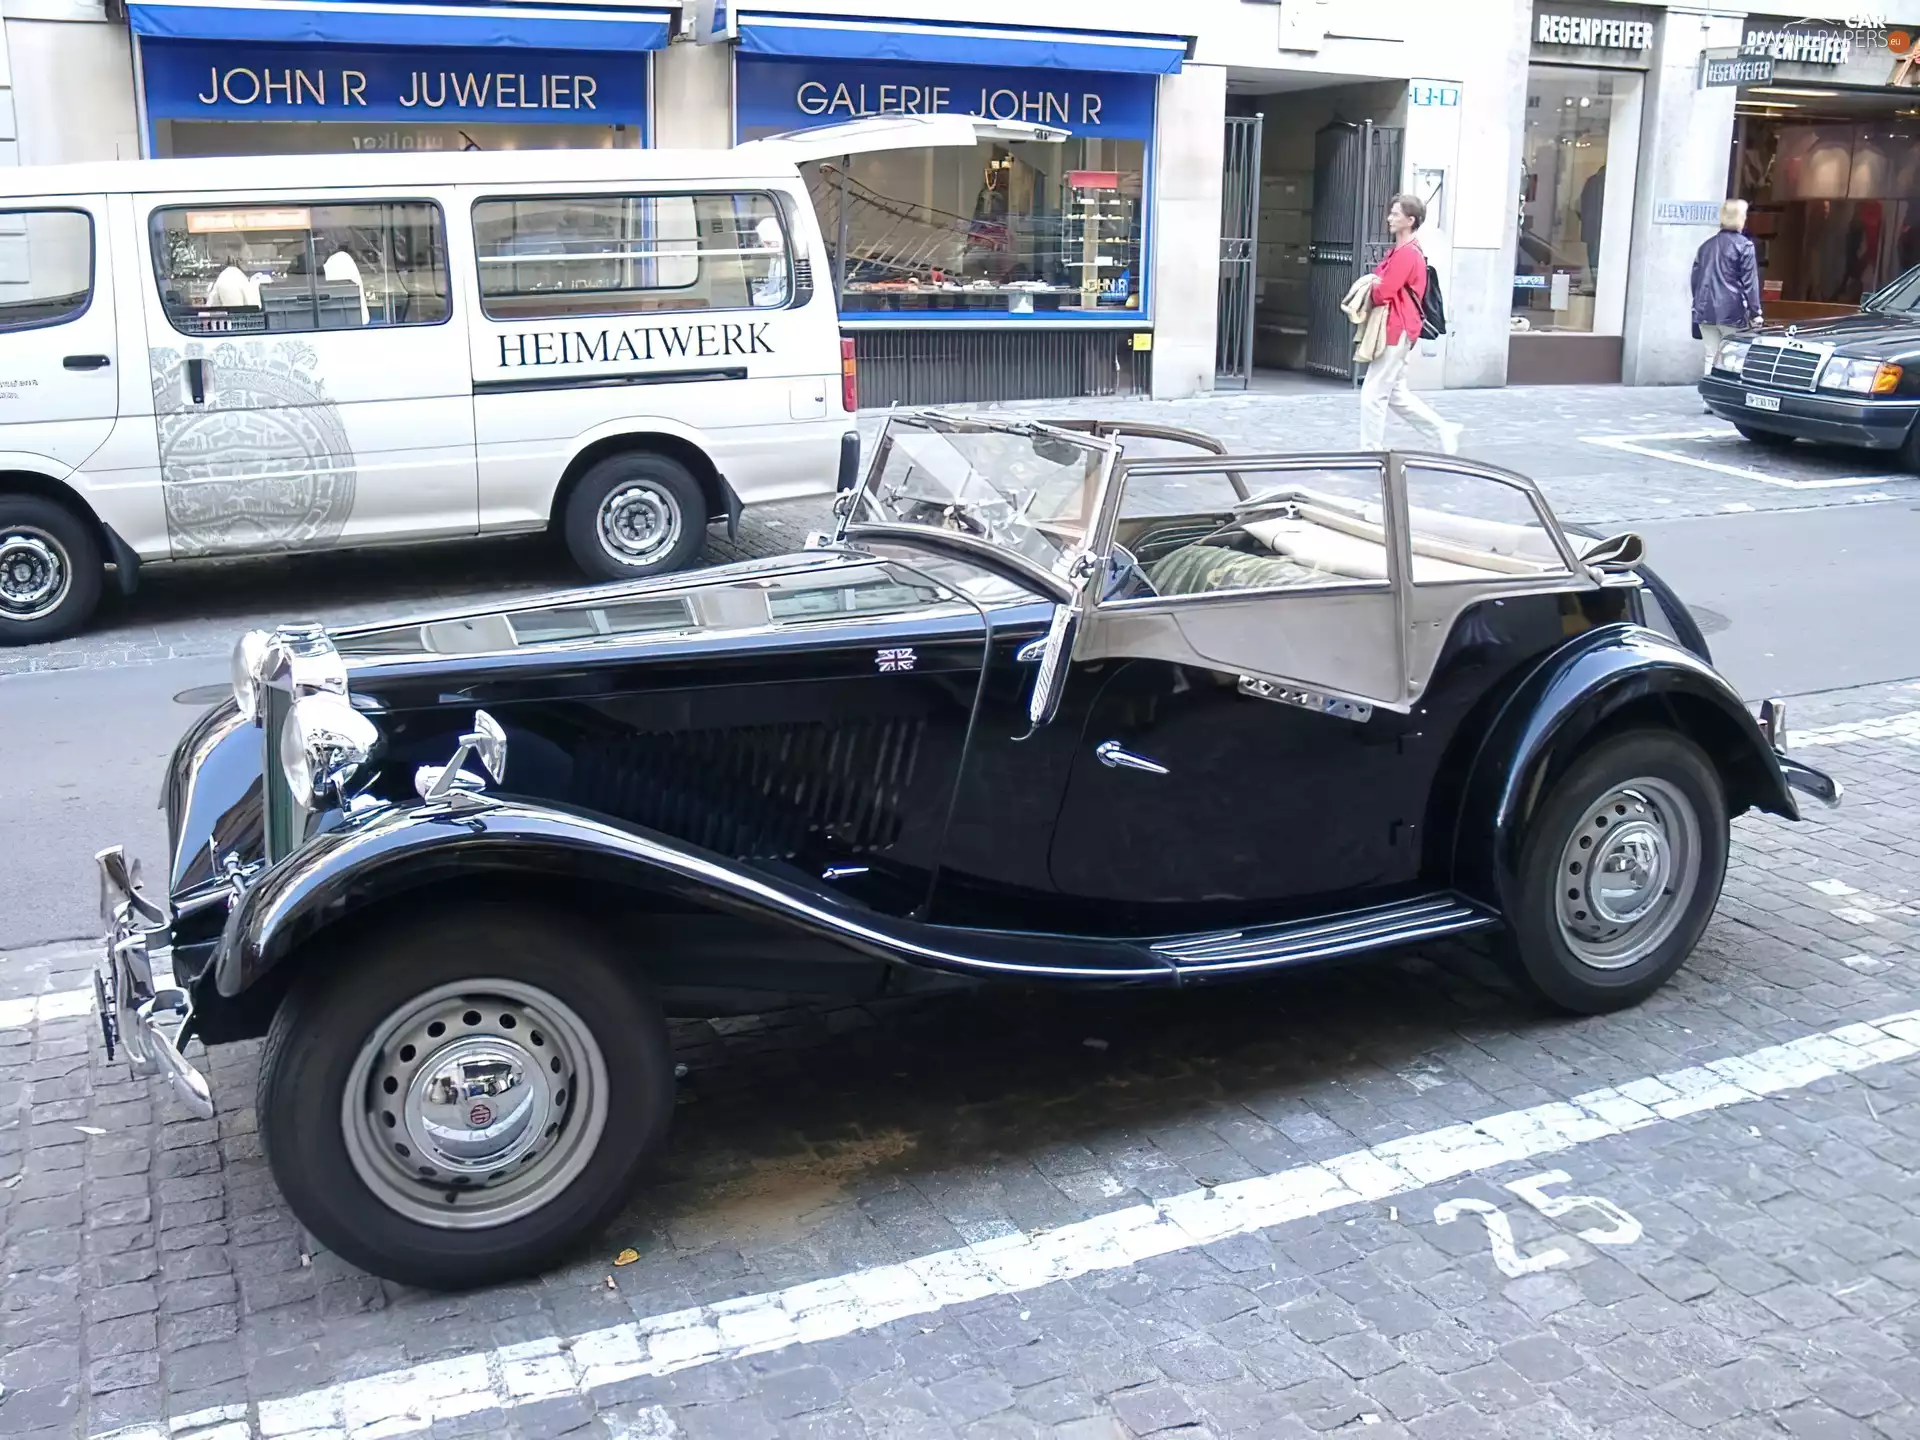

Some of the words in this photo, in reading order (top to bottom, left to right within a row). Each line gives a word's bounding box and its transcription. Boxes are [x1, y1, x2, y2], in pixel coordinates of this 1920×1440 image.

[1539, 14, 1653, 50] REGENPFEIFER
[198, 66, 325, 105] JOHN
[343, 70, 367, 105] R
[399, 71, 598, 109] JUWELIER
[796, 81, 950, 115] GALERIE
[970, 87, 1069, 123] JOHN
[1082, 93, 1102, 124] R
[497, 321, 776, 368] HEIMATWERK
[1433, 1168, 1643, 1279] 25
